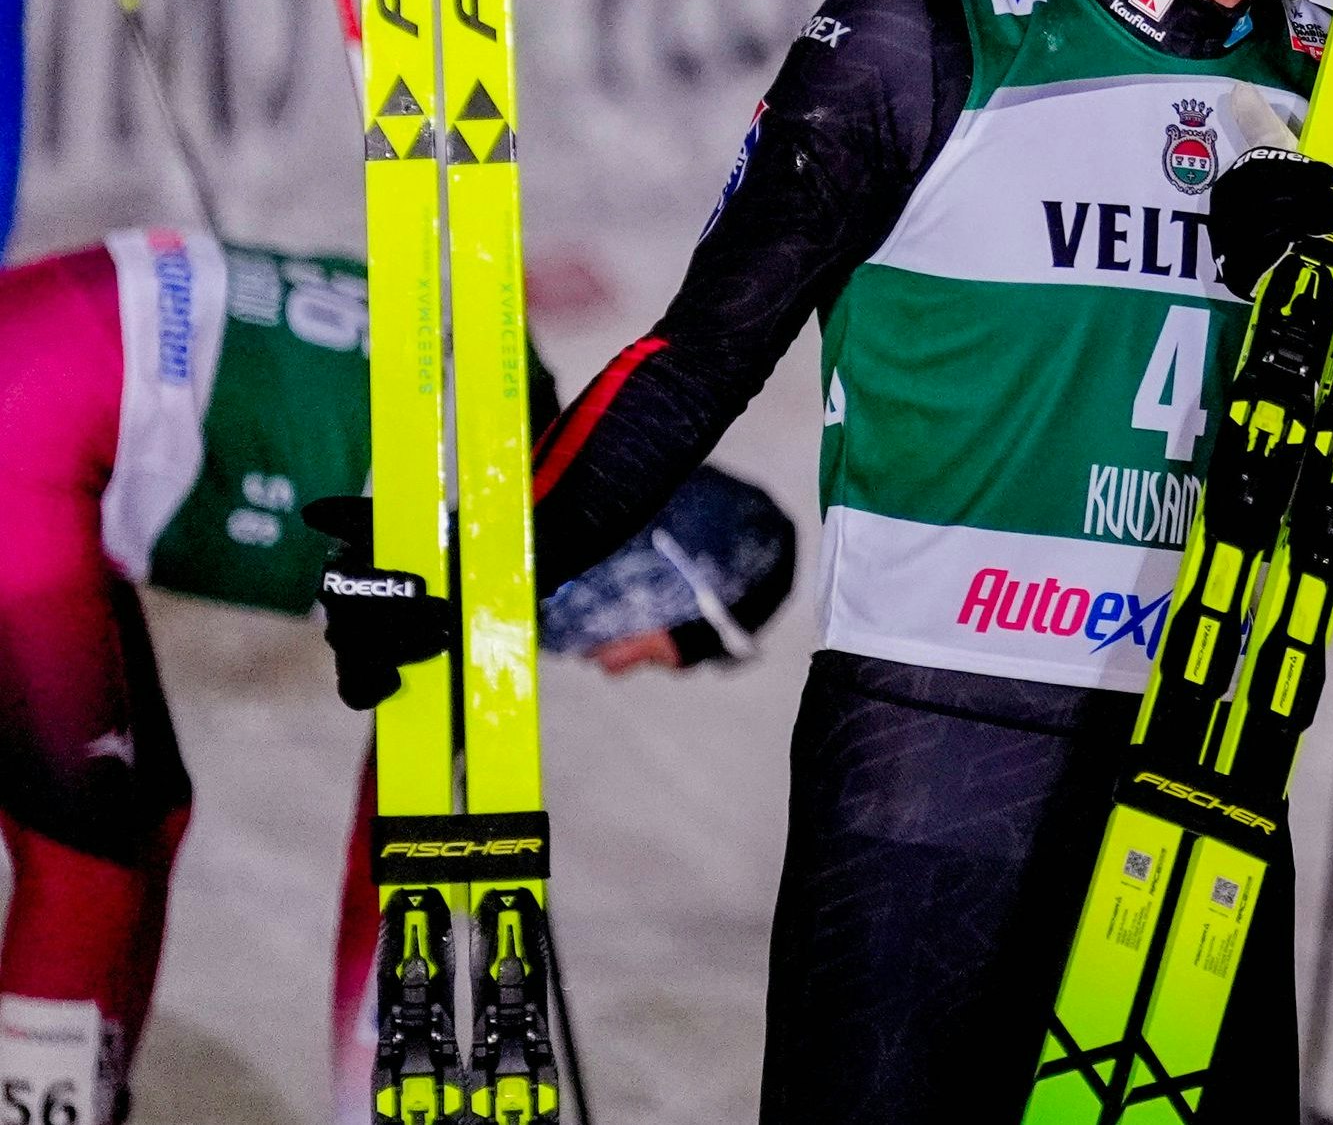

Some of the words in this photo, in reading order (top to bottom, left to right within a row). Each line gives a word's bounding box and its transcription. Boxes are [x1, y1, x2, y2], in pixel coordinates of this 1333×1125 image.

[1042, 200, 1223, 282] VELT
[1131, 305, 1211, 462] 4
[1083, 463, 1202, 545] KUUSAM
[1133, 771, 1277, 836] FISCHER
[380, 838, 544, 858] FISCHER
